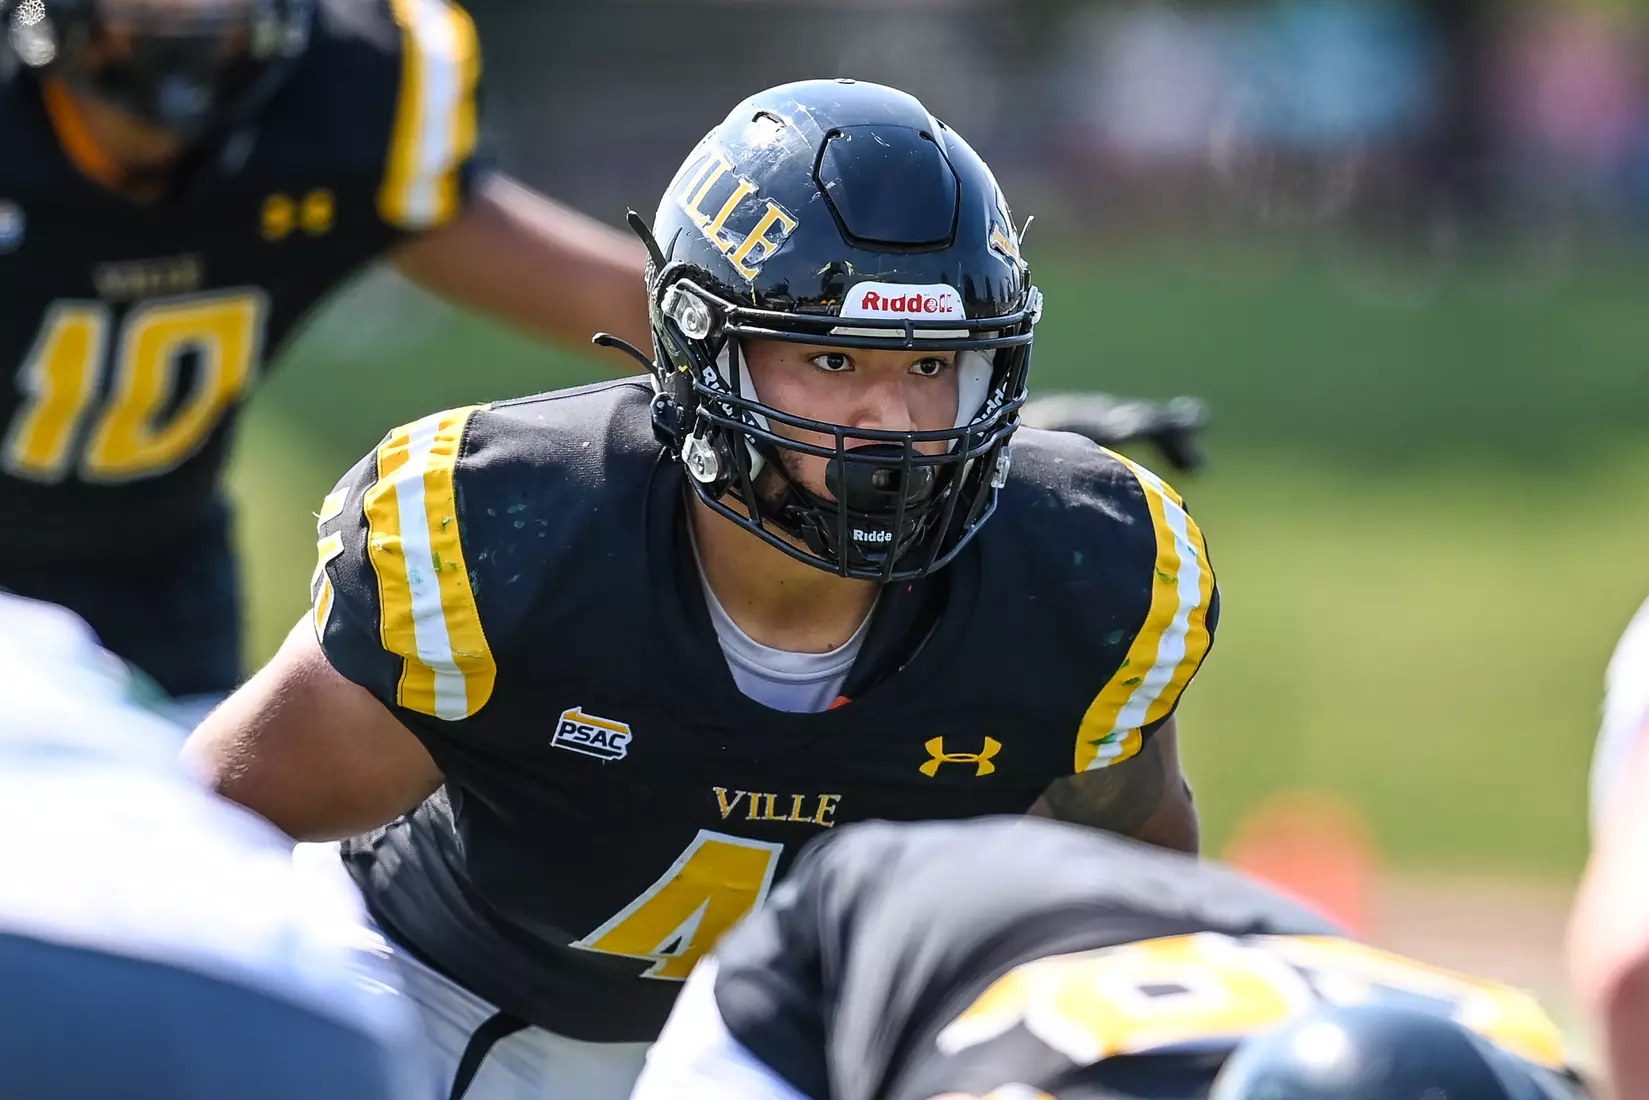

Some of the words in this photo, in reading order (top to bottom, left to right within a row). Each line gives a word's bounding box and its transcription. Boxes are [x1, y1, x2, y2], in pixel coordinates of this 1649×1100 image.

[669, 150, 797, 281] ILLE
[4, 288, 264, 483] 10
[853, 529, 893, 542] Ridde
[558, 721, 626, 750] PSAC
[712, 786, 842, 828] VILLE
